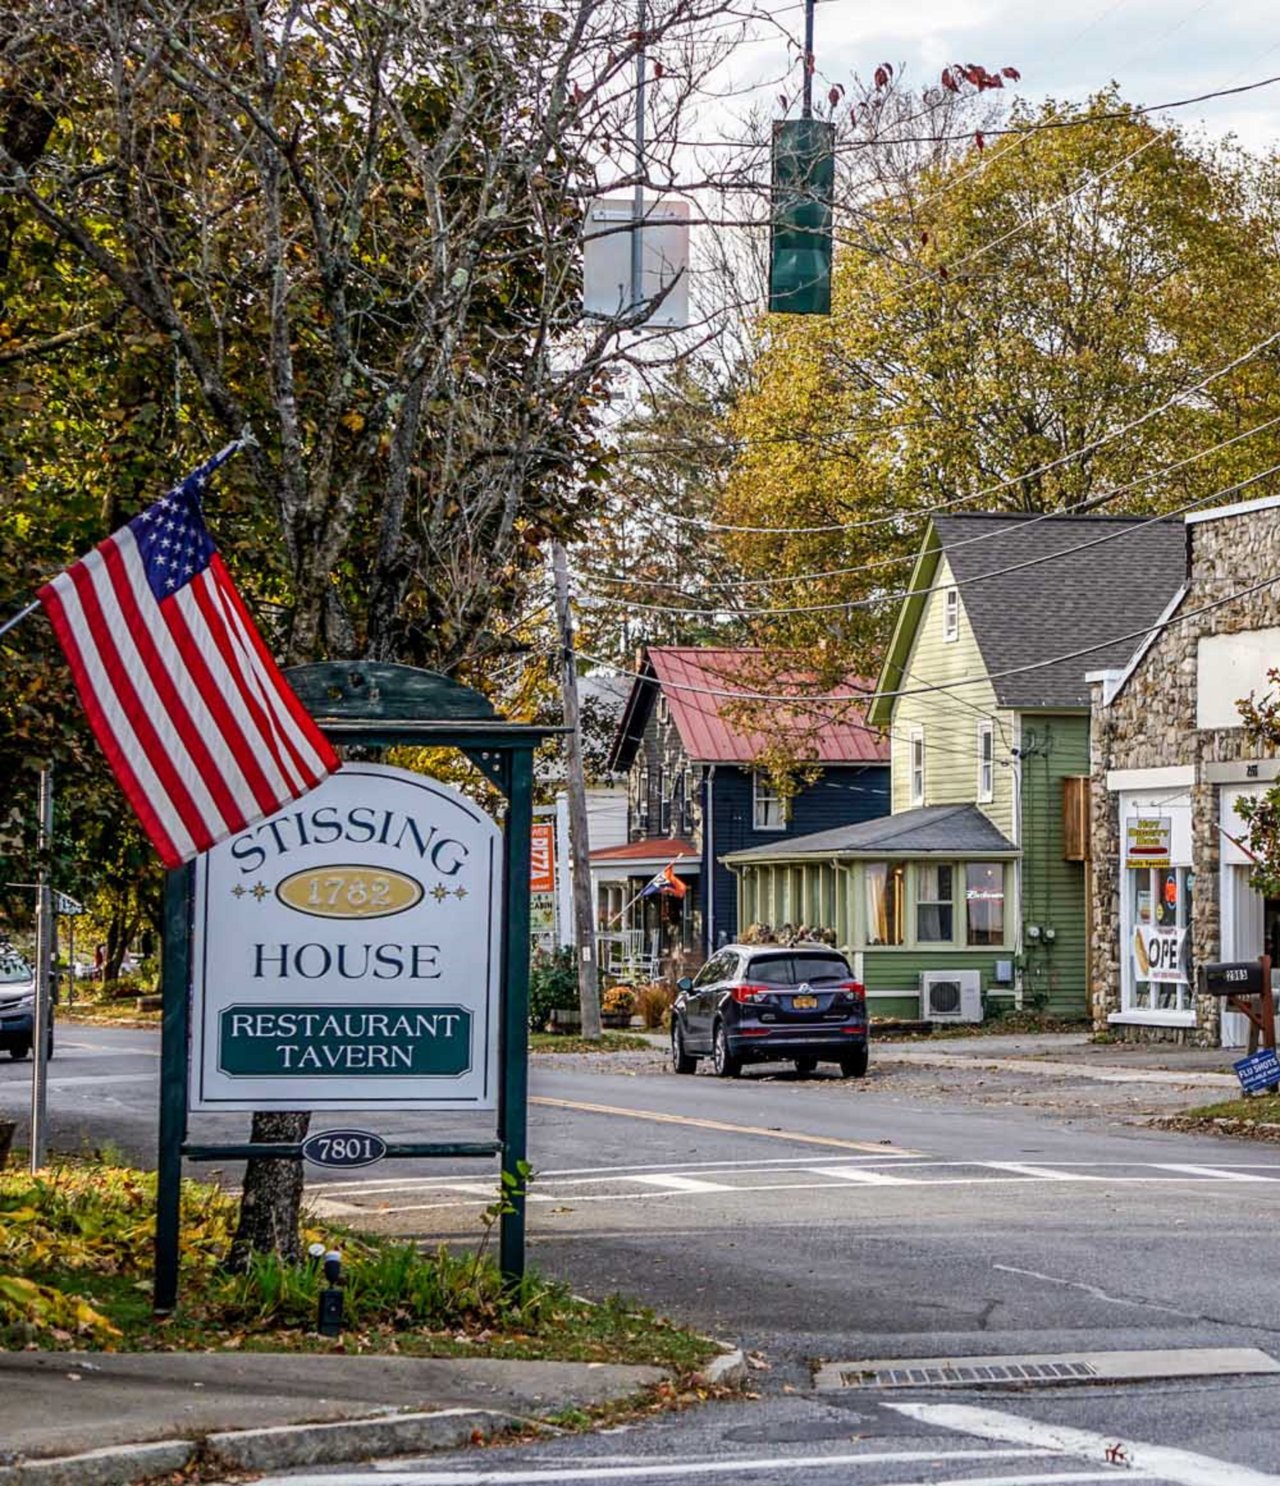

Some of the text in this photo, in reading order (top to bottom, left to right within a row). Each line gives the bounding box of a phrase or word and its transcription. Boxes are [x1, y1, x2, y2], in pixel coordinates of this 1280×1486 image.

[230, 807, 469, 876] STISSING
[531, 838, 549, 879] PIZZA
[308, 878, 391, 907] 1782
[253, 943, 442, 979] HOUSE
[1148, 938, 1178, 970] OPE
[231, 1014, 460, 1038] RESTAURANT
[276, 1045, 415, 1067] TAVERN
[1239, 1067, 1253, 1079] FLU
[1253, 1058, 1277, 1073] SHOTS
[317, 1139, 373, 1160] 7801
